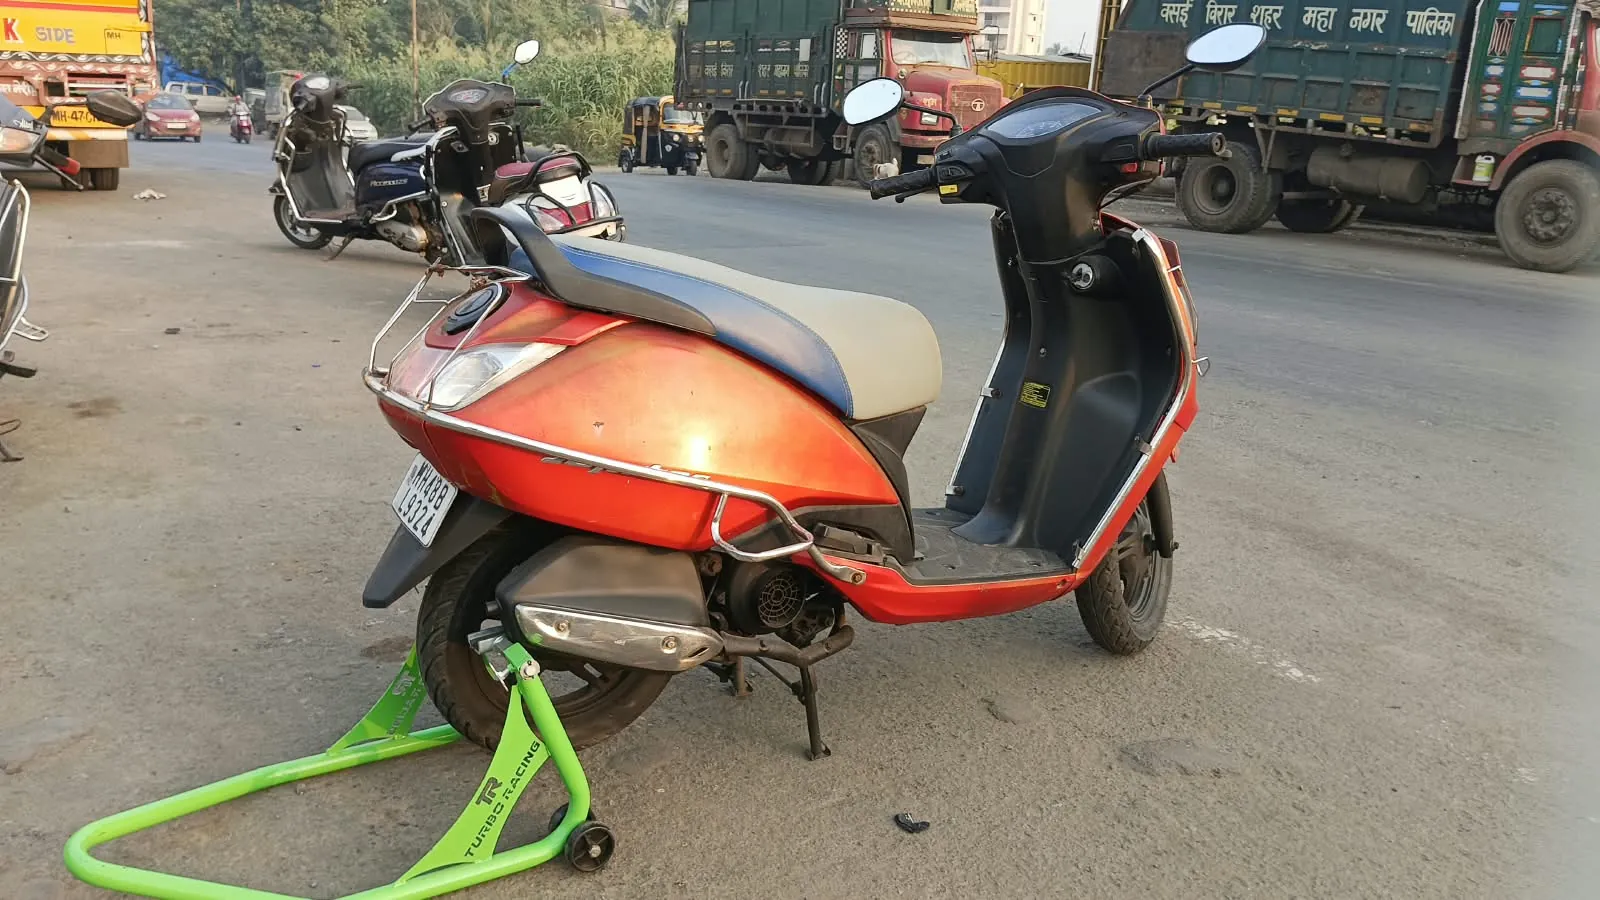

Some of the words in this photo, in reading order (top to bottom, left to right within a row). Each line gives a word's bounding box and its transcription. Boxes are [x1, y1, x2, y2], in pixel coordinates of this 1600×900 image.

[35, 26, 76, 45] SIDE
[1160, 0, 1193, 28] वसई
[1205, 0, 1238, 24] विरार
[1250, 5, 1284, 30] शहर
[1302, 6, 1338, 32] महा
[1350, 8, 1389, 33] नगर
[1406, 7, 1456, 36] पालिका
[464, 802, 505, 858] TURBO
[502, 740, 541, 800] RACING
